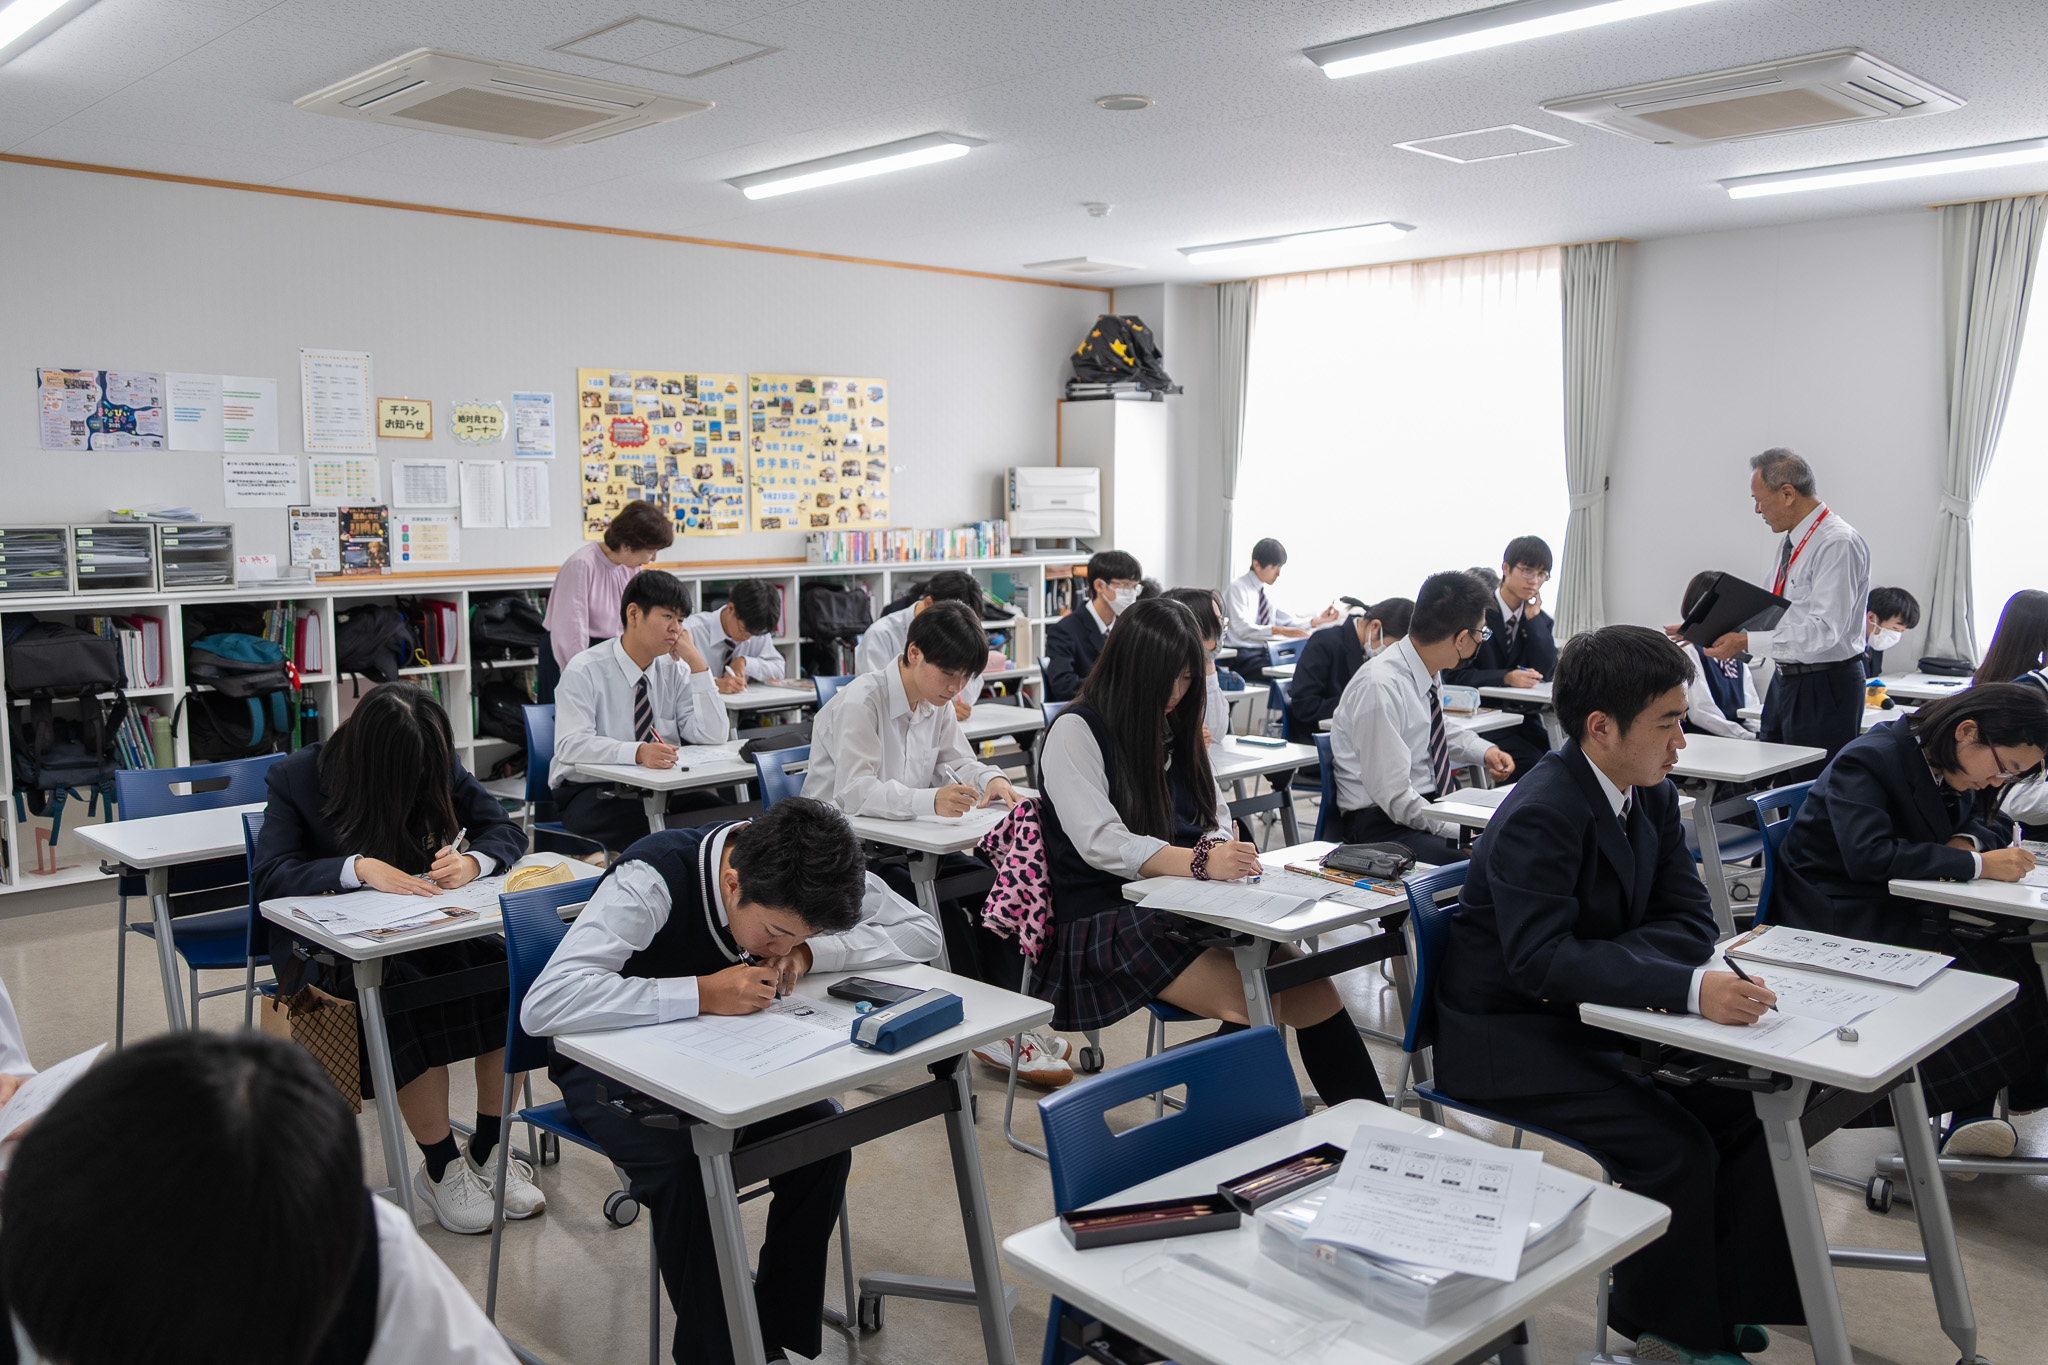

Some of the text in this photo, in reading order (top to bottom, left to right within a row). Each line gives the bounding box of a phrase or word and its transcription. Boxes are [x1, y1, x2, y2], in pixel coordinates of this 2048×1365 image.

[390, 405, 419, 416] チラシ
[384, 419, 424, 430] お知らせ
[466, 426, 496, 434] コーナー
[652, 424, 670, 435] 万博
[756, 458, 800, 470] 修学旅行
[350, 521, 380, 536] UMA
